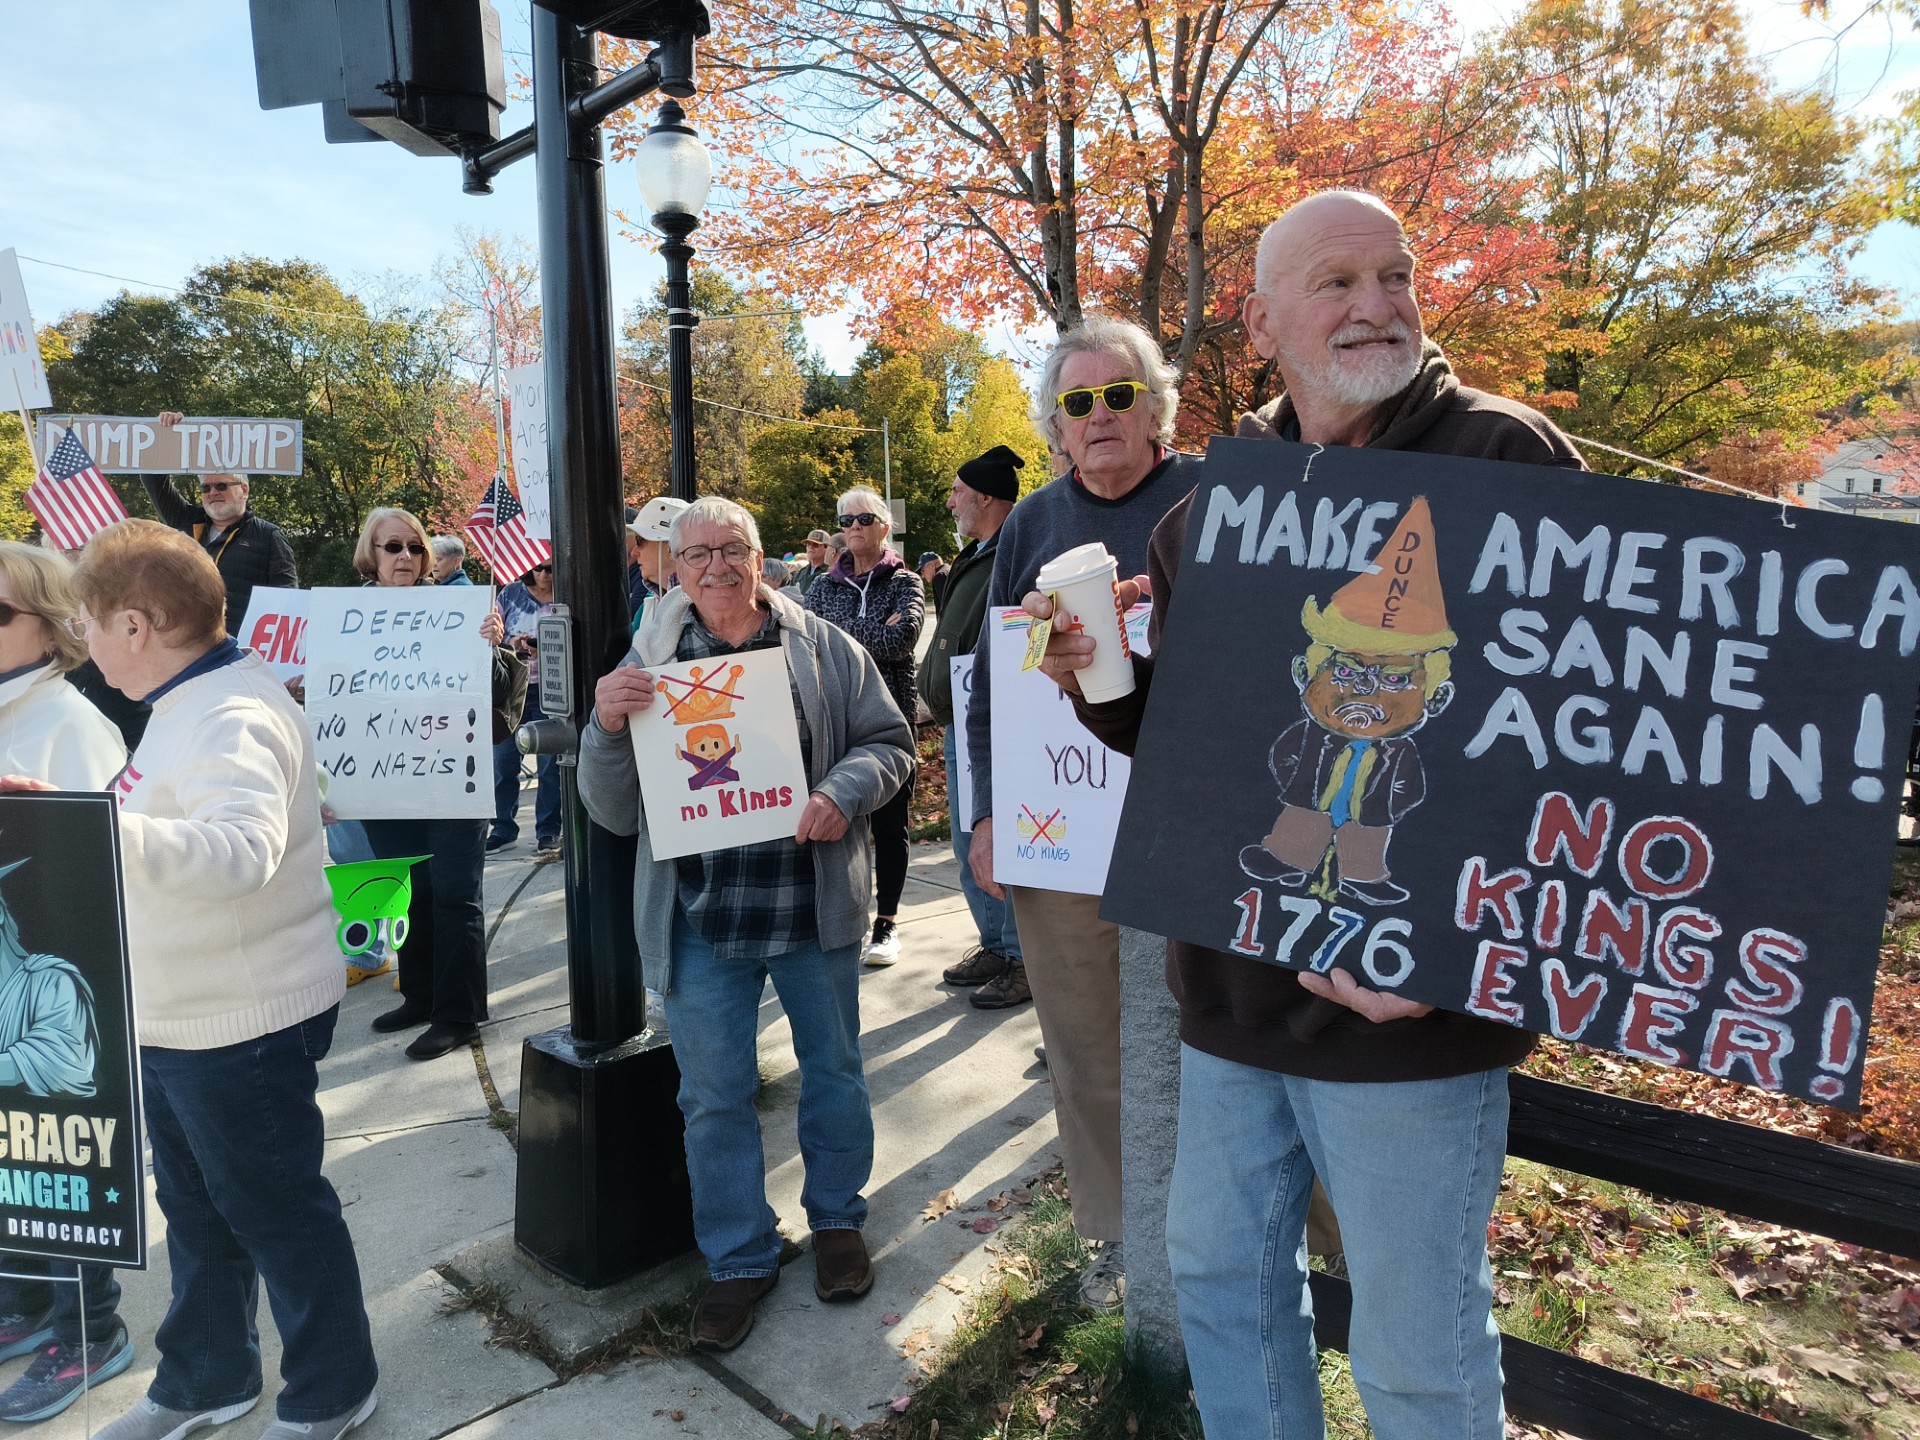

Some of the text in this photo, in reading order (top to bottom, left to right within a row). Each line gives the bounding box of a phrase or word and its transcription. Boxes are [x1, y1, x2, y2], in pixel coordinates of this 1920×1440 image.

[172, 423, 296, 469] TRUMP
[1194, 484, 1920, 657] MAKE AMERICA
[1381, 531, 1421, 629] DUNCE
[341, 609, 465, 635] DEFEND
[544, 630, 560, 640] PUSH
[374, 641, 422, 662] OUR
[542, 643, 564, 653] BUTTON
[546, 655, 560, 665] WAIT
[1482, 608, 1769, 710] SANE
[328, 669, 468, 697] DEMOCRACY
[546, 680, 562, 691] WALK
[548, 668, 560, 678] FOR
[544, 693, 565, 704] SIGNAL
[317, 713, 346, 741] NO
[323, 752, 356, 778] NO
[1045, 744, 1107, 790] YOU
[680, 786, 793, 821] no Kings
[1017, 845, 1070, 862] NO KINGS
[1526, 791, 1714, 901] NO
[1229, 886, 1416, 987] 1776
[1455, 856, 1808, 1016] KINGS
[0, 1110, 117, 1168] RACY
[8, 1217, 122, 1247] DEMOCRACY
